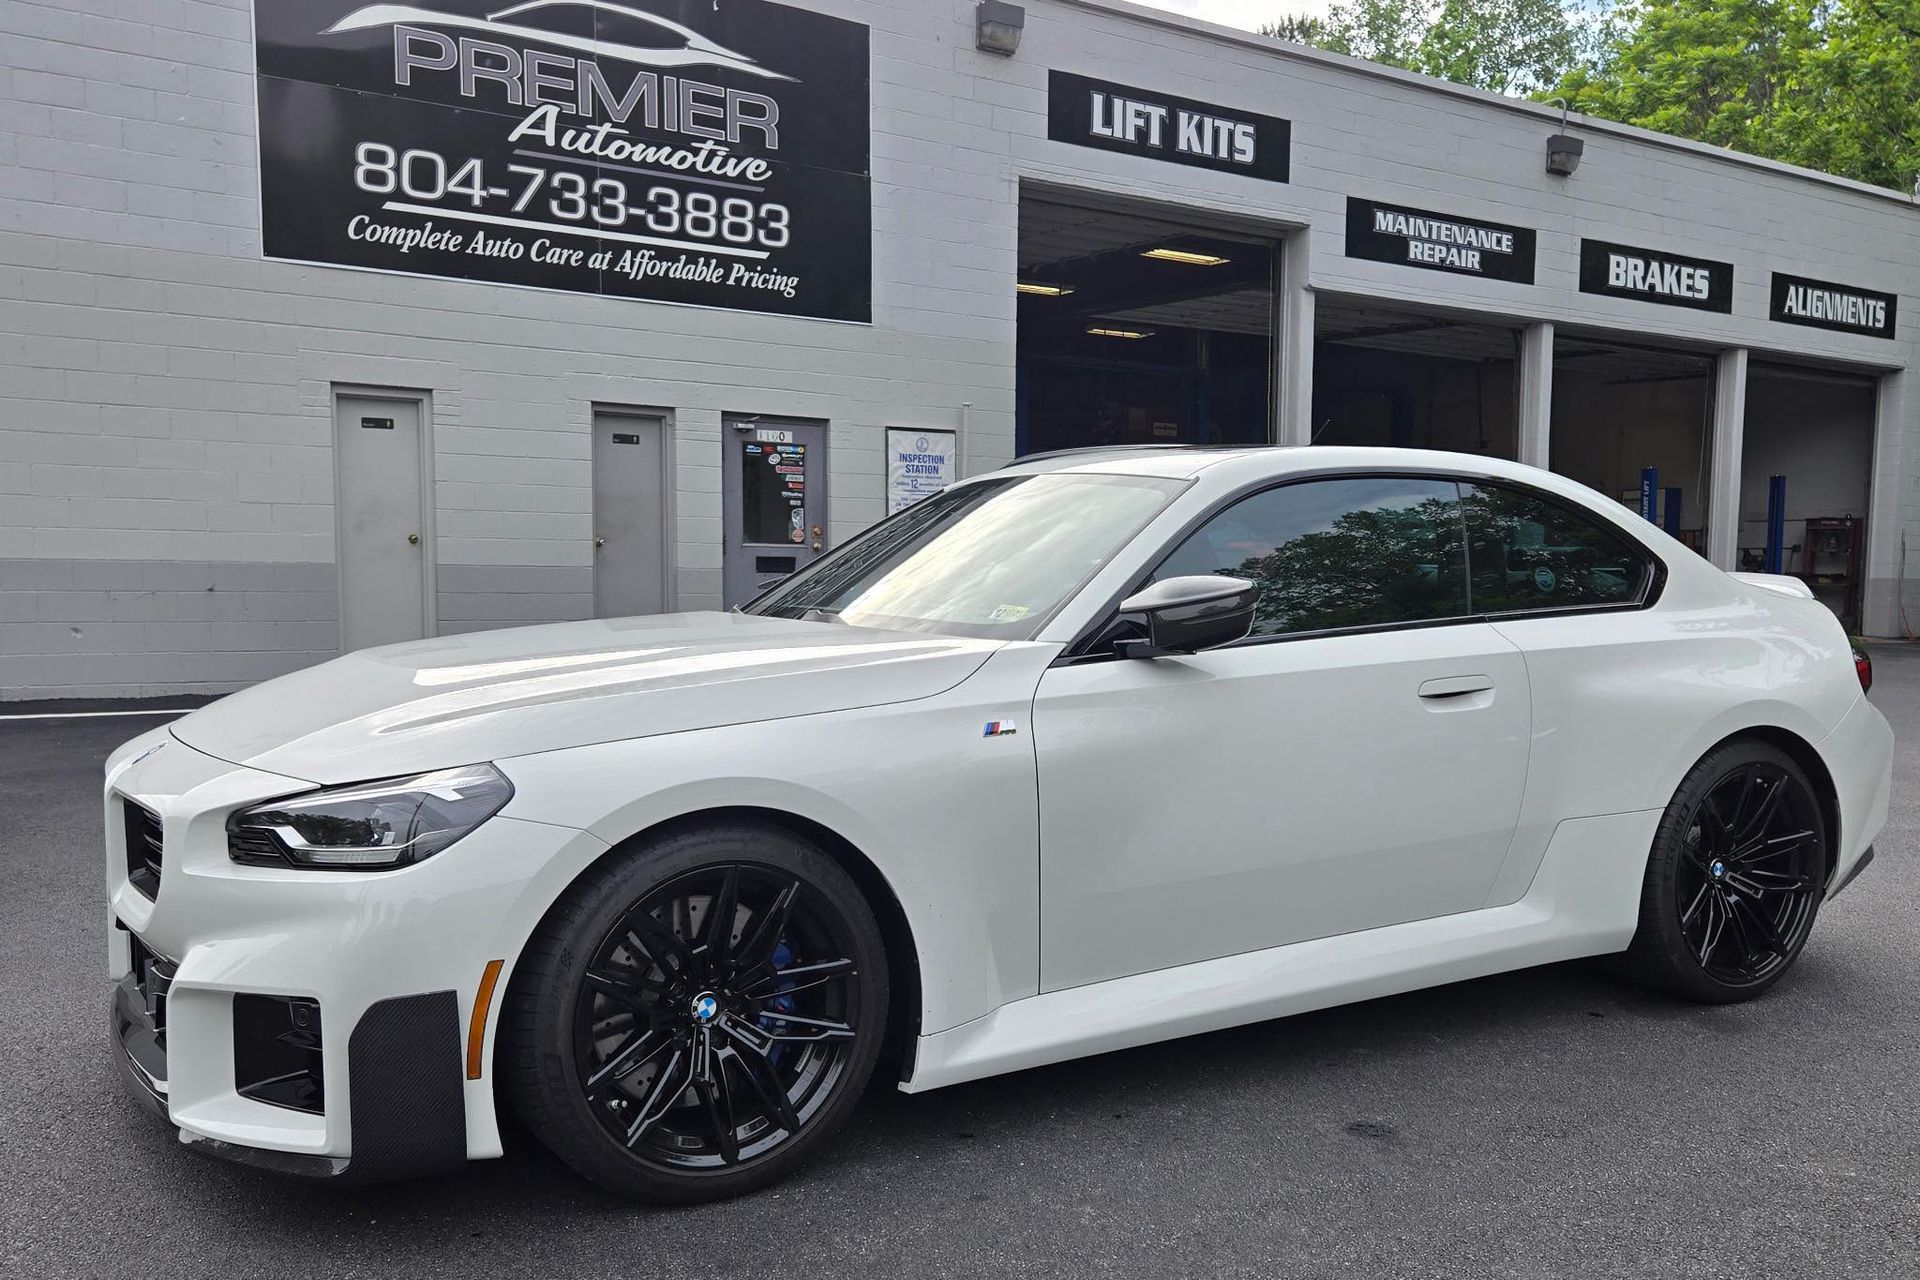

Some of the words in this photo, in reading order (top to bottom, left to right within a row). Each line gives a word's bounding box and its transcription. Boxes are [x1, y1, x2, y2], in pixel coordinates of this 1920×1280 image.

[393, 24, 780, 150] PREMIER
[507, 104, 773, 182] Automotive
[1090, 90, 1169, 148] LIFT
[1175, 108, 1257, 165] KITS
[354, 141, 791, 248] 804-733-3883
[1373, 208, 1514, 255] MAINTENANCE
[1407, 238, 1483, 272] REPAIR
[347, 214, 464, 253] Complete
[465, 230, 525, 259] Auto
[530, 238, 584, 267] Care
[587, 249, 613, 270] at
[614, 249, 725, 283] Affordable
[726, 262, 800, 298] Pricing
[1608, 253, 1710, 300] BRAKES
[1782, 284, 1887, 328] ALIGNMENTS
[900, 453, 945, 465] INSPECTION
[905, 464, 939, 475] STATION
[911, 479, 919, 489] 12
